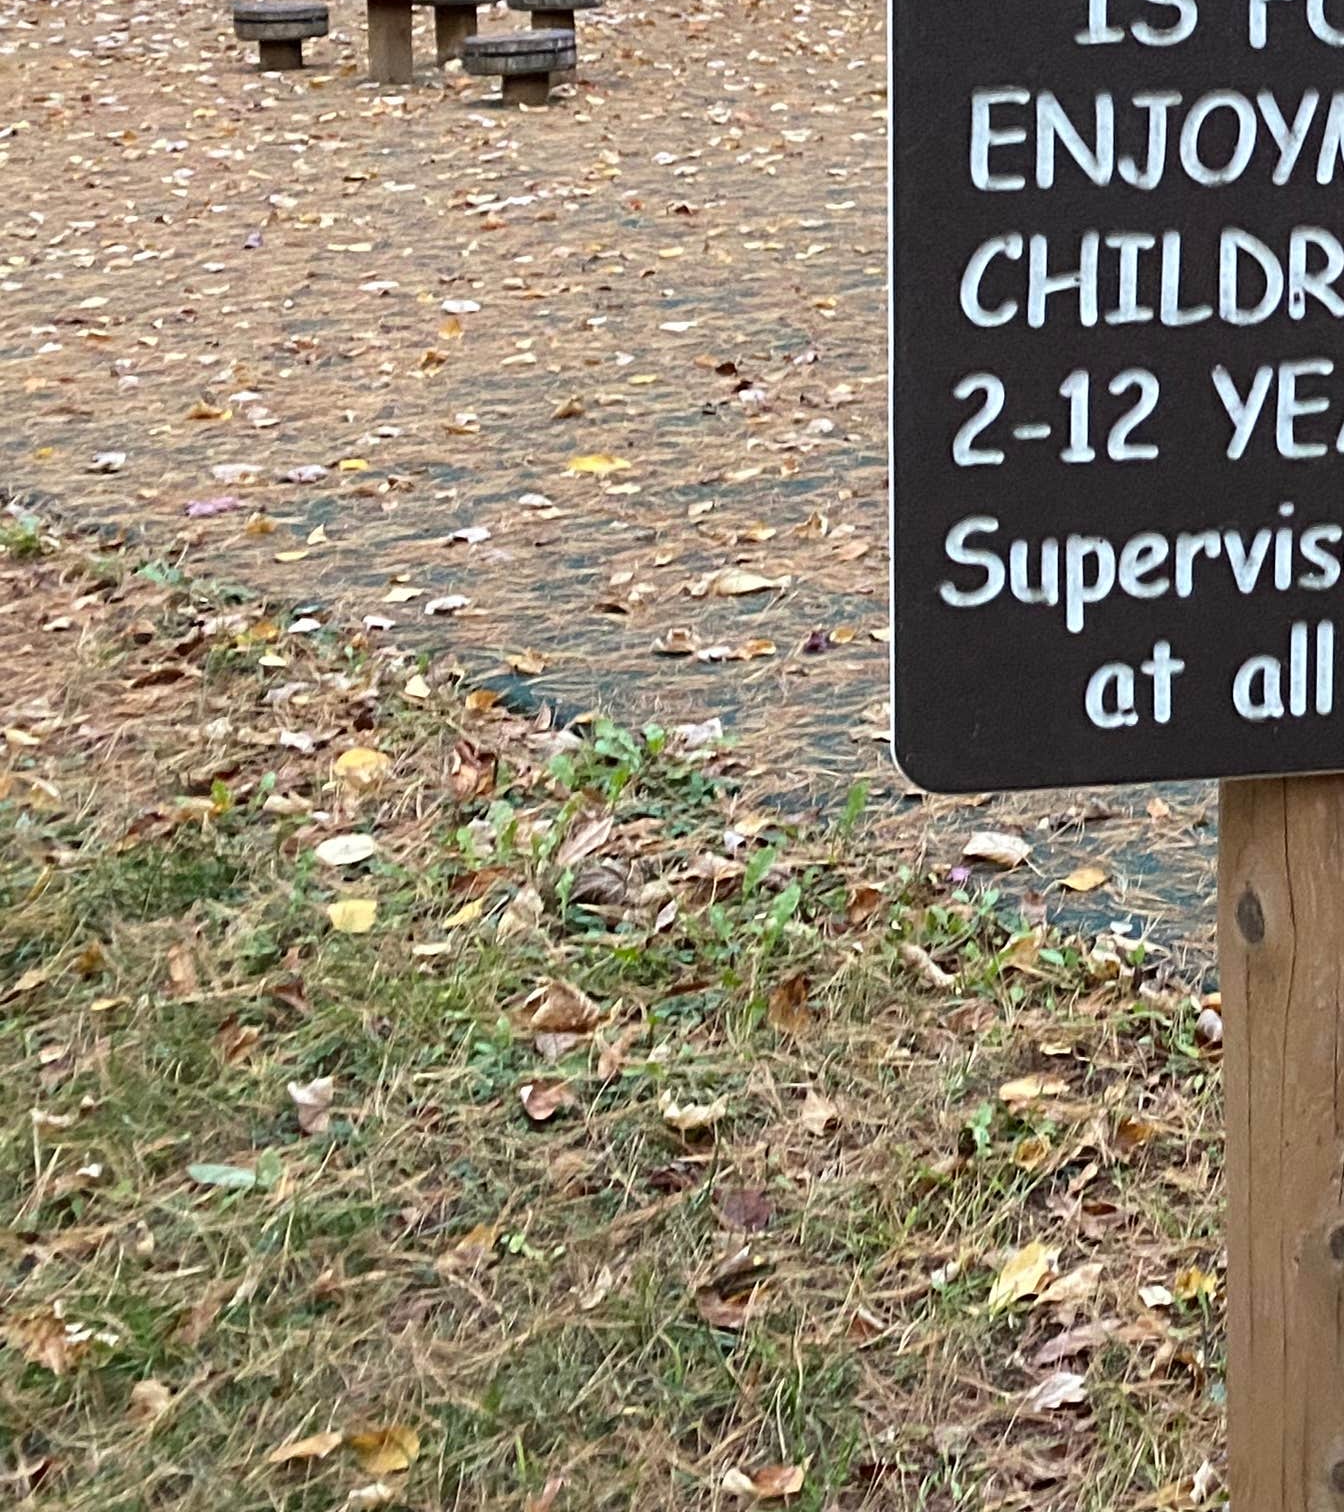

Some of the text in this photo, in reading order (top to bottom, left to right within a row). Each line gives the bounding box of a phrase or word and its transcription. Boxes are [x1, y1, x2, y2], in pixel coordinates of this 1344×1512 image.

[952, 368, 1160, 467] 2-12
[1085, 641, 1185, 729] at
[1232, 620, 1334, 720] all
